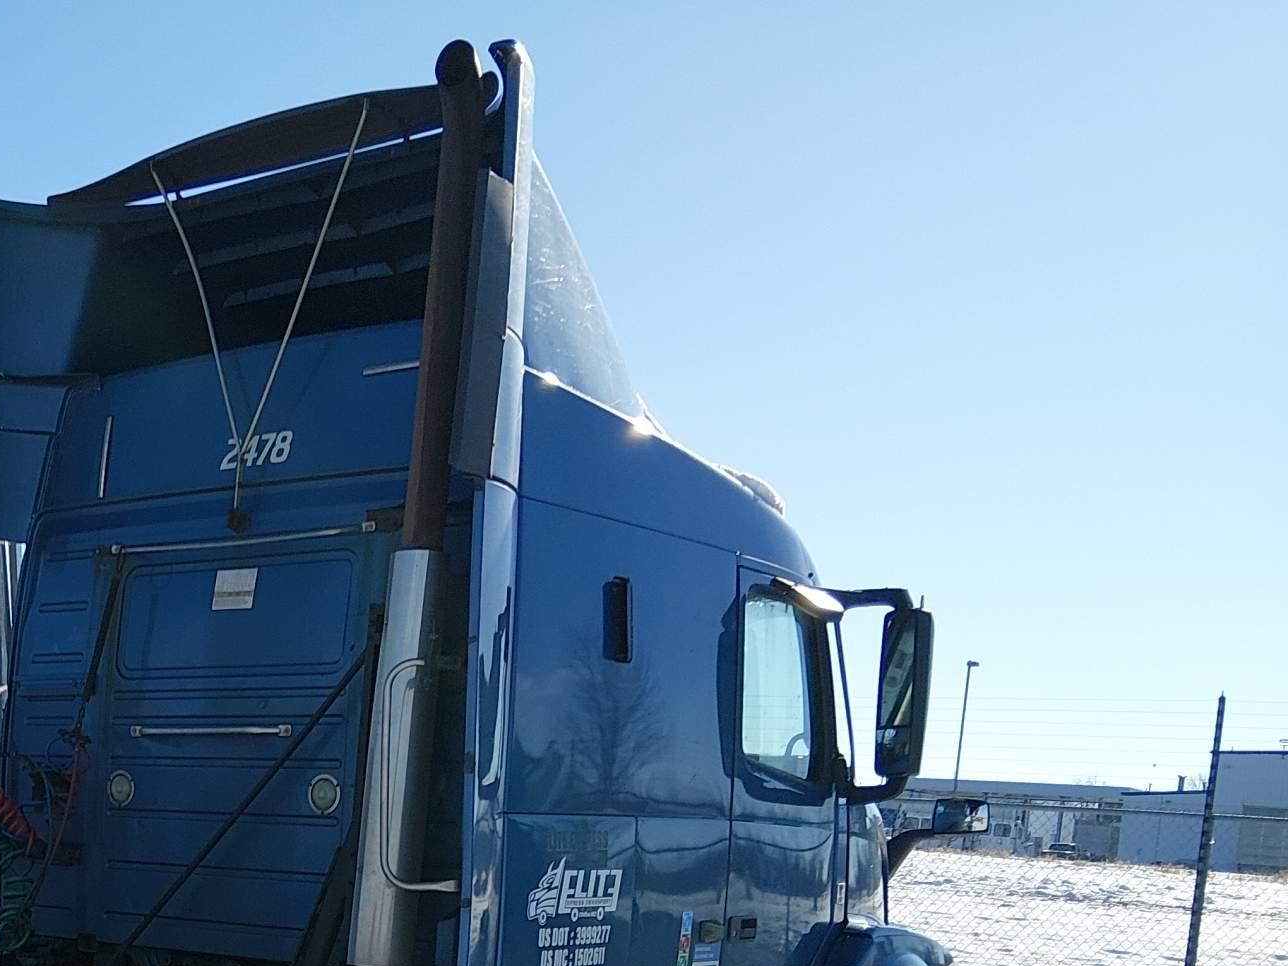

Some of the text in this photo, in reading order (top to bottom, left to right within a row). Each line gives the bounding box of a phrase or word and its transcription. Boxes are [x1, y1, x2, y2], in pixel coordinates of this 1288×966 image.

[220, 430, 293, 471] 2478
[558, 869, 623, 914] ELITE
[538, 928, 551, 947] US
[575, 925, 611, 945] 3999277
[574, 947, 606, 966] 1502611
